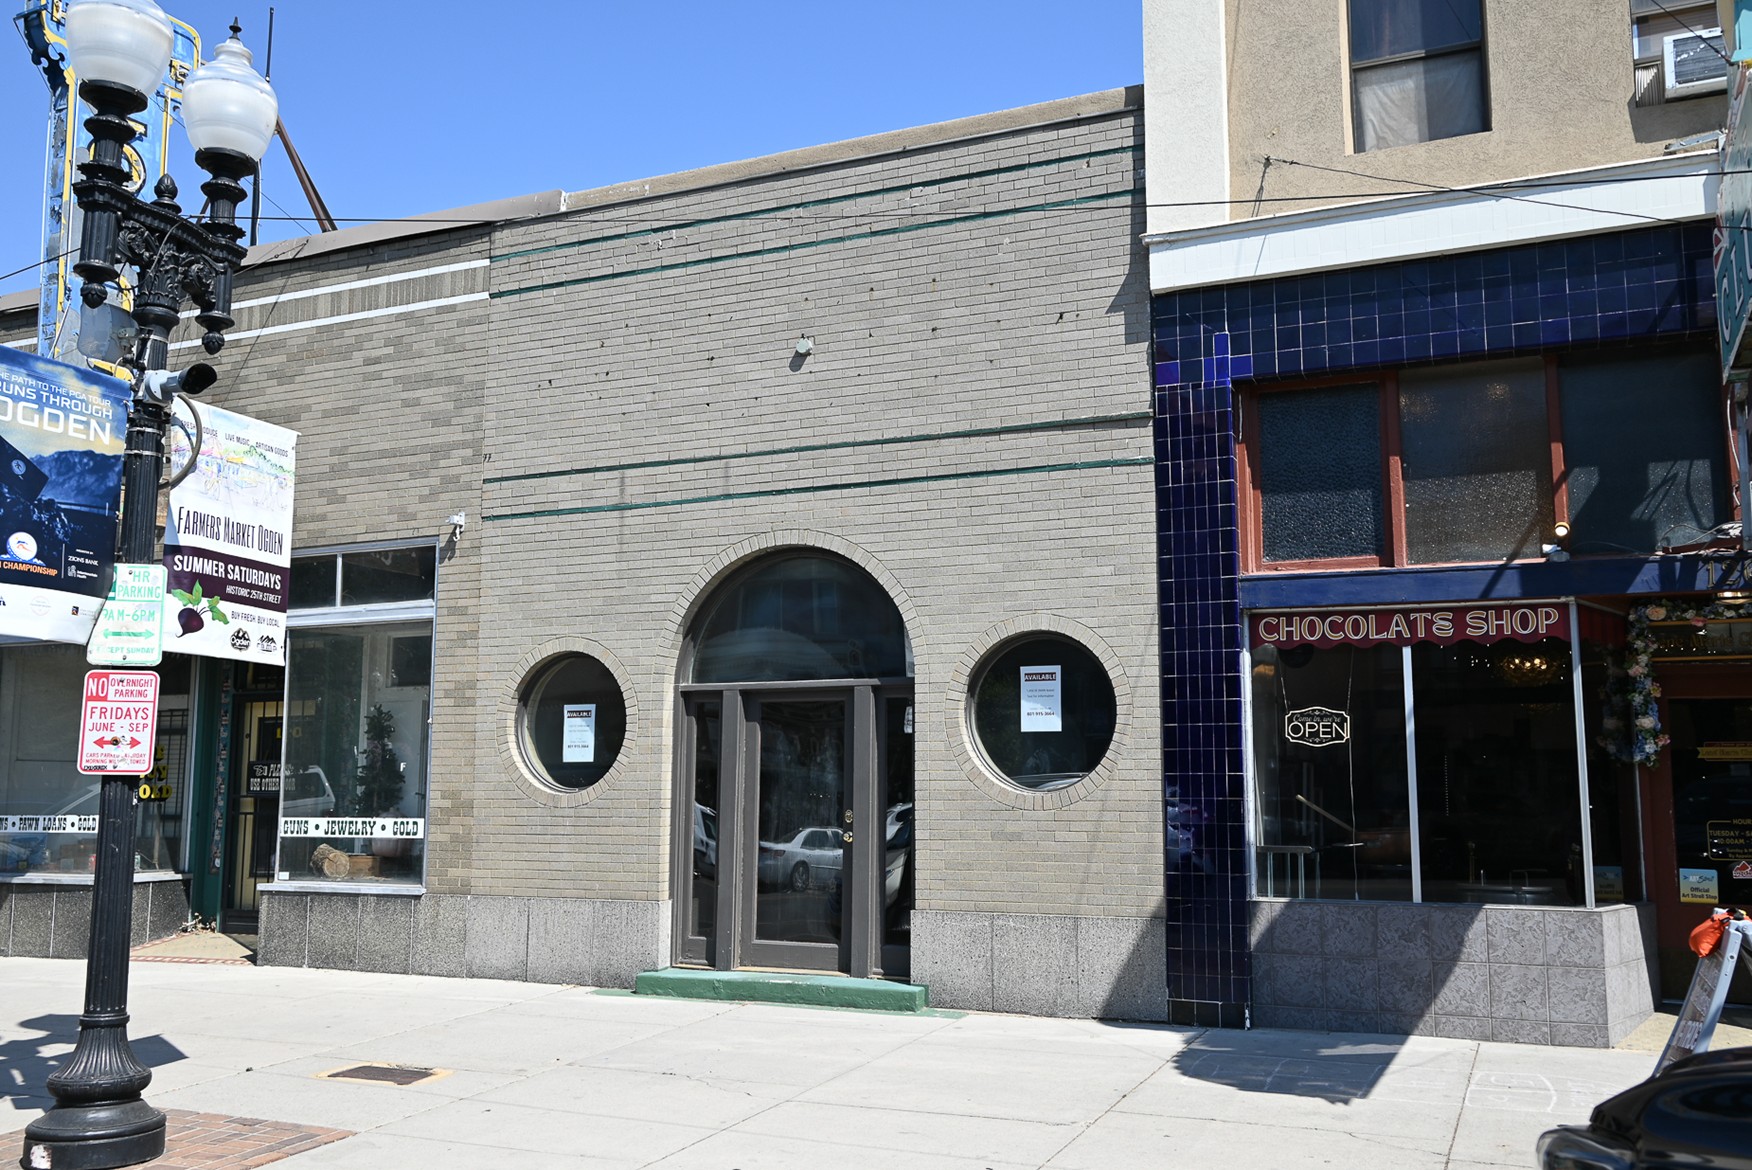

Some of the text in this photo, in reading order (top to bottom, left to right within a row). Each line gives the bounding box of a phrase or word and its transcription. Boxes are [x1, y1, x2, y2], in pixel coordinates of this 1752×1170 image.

[0, 373, 111, 407] HE PATH TO THE PGA TOUR
[40, 391, 112, 420] THROUGH
[0, 395, 111, 445] OGDEN
[225, 432, 250, 446] LIVE MUSIC
[255, 441, 289, 458] ARTISAN GOODS
[177, 506, 284, 556] FARMERS MARKET OGDEN
[3, 561, 58, 577] CHAMPIONSHIP
[132, 570, 151, 583] HR
[173, 554, 281, 590] SUMMER SATURDAYS
[117, 585, 161, 598] PARKING
[226, 584, 250, 597] HISTORIC
[263, 591, 282, 604] STREET
[1259, 607, 1560, 641] CHOCOLATE SHOP
[126, 646, 155, 654] SUNDAY
[110, 678, 153, 688] OVERNIGHT
[1024, 673, 1056, 681] AVAILABLE
[87, 677, 107, 697] NO
[114, 689, 148, 699] PARKING
[90, 706, 149, 720] FRIDAYS
[88, 722, 116, 732] JUNE
[128, 722, 149, 732] SEP
[1288, 722, 1347, 738] OPEN
[138, 783, 173, 799] OLD
[250, 778, 261, 791] USE
[261, 778, 280, 791] OTHER
[18, 816, 40, 831] PAWN
[42, 817, 67, 831] LOANS
[77, 817, 97, 831] GOLD
[283, 819, 419, 836] GUNS JEWELRY GOLD
